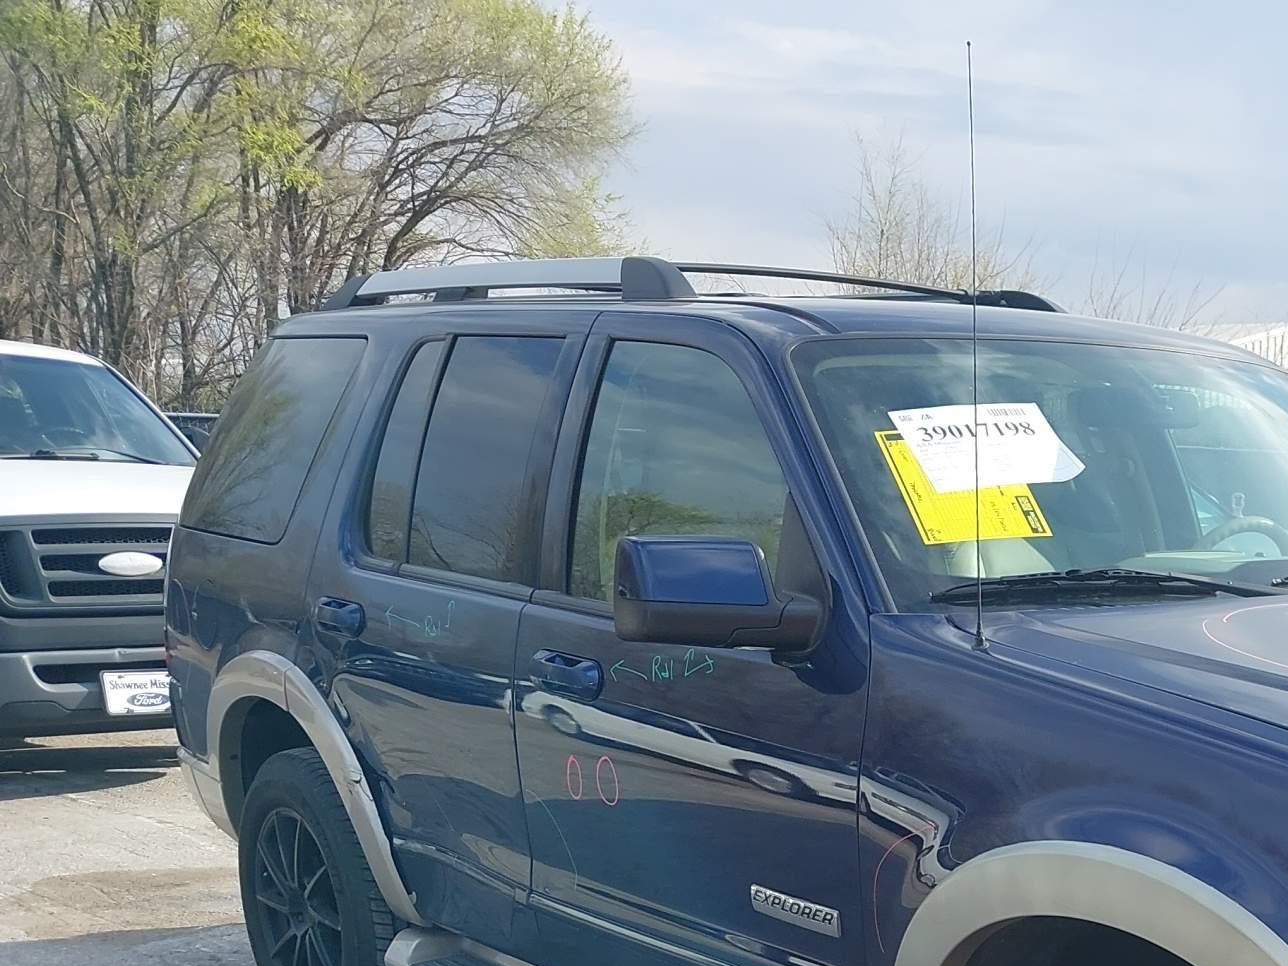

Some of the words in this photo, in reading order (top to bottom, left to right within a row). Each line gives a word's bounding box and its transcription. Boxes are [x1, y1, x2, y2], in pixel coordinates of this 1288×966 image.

[916, 421, 1036, 442] 39017198
[109, 680, 149, 690] Shawnee
[134, 694, 163, 705] Ford
[753, 889, 834, 926] EXPLORER
